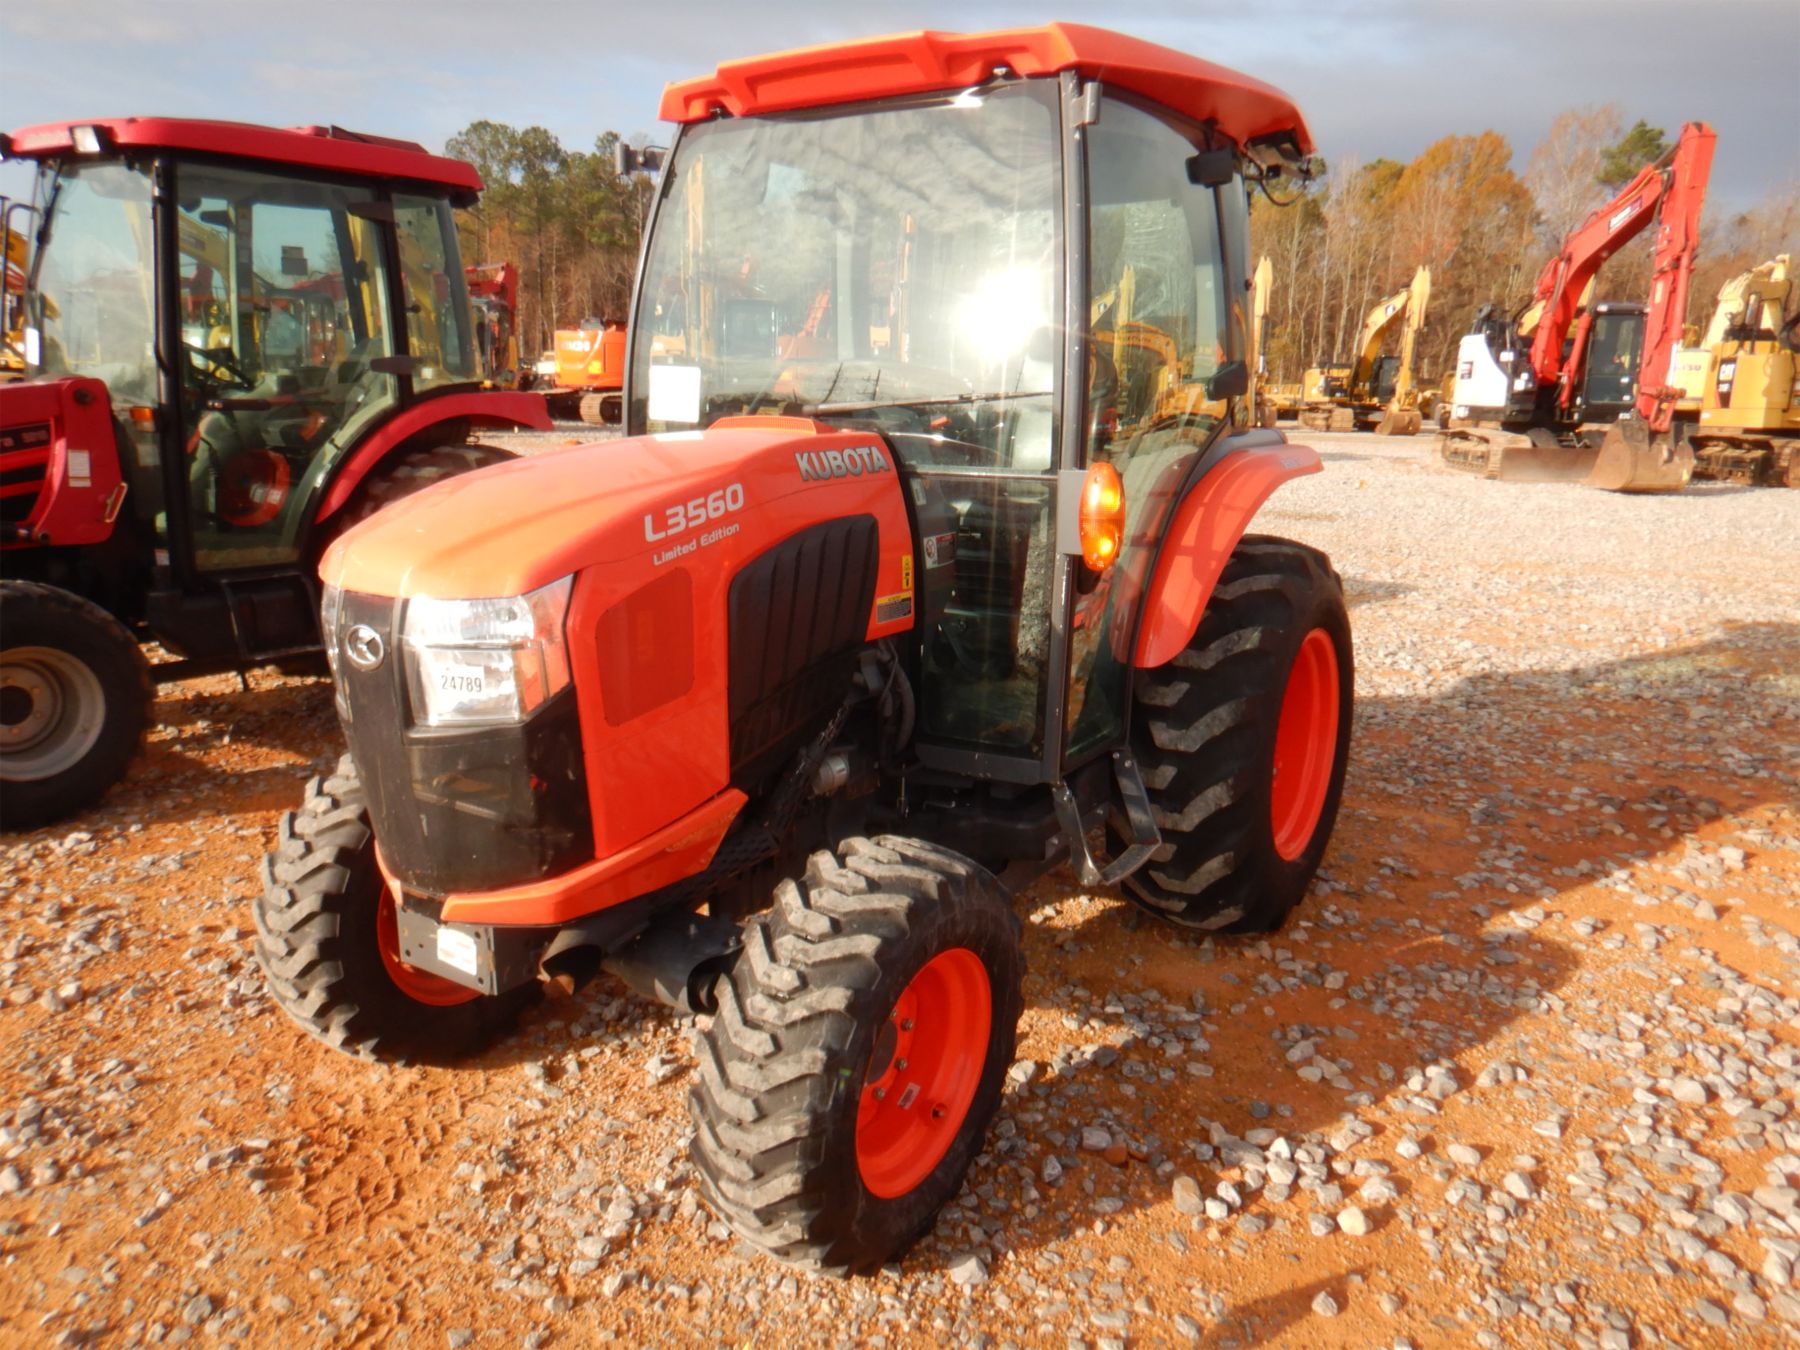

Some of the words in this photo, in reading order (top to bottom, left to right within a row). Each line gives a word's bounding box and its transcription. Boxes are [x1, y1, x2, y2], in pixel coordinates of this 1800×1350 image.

[795, 446, 890, 481] KUBOTA
[644, 483, 744, 542] L3560
[653, 538, 697, 566] Limited
[701, 523, 740, 547] Edition
[441, 674, 482, 692] 24789
